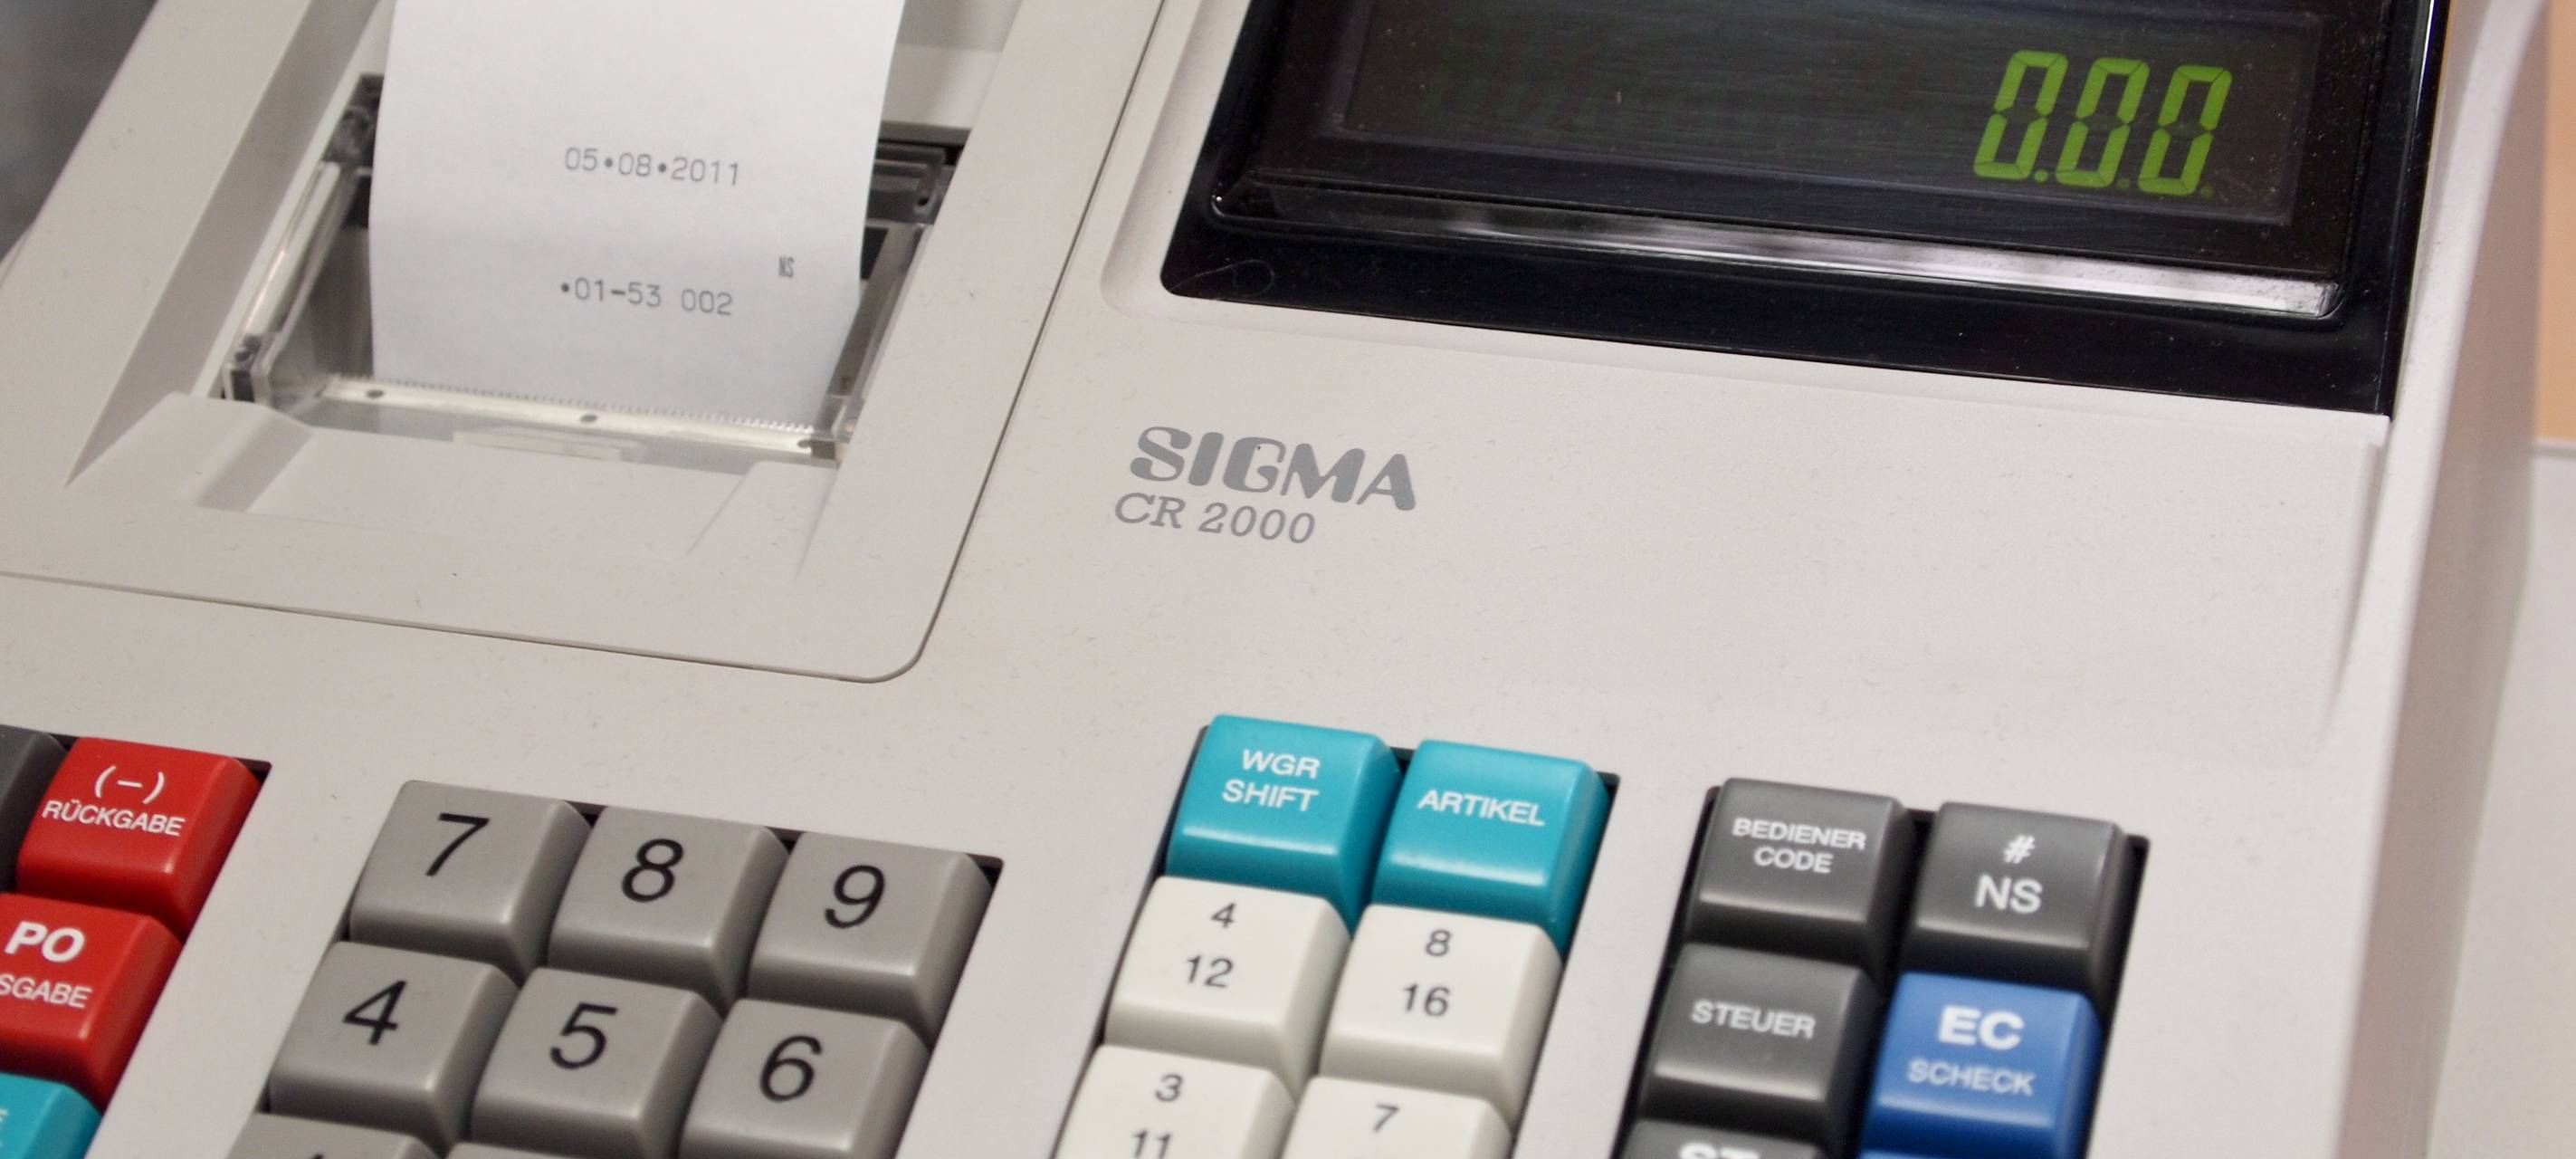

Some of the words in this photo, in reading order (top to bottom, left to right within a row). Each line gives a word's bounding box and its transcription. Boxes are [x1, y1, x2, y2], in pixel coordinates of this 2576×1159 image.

[1973, 50, 2232, 196] 0.00
[778, 256, 794, 278] NS
[681, 288, 734, 316] 002
[1130, 426, 1417, 512] SIGMA
[1114, 492, 1187, 530] CR
[1197, 502, 1316, 544] 2000
[1241, 748, 1321, 780] WGR
[1221, 779, 1320, 813] SHIFT
[1417, 789, 1547, 828] ARTIKEL
[42, 799, 186, 837] RÜCKGABE
[1732, 817, 1867, 851] BEDIENER
[434, 812, 490, 878] 7
[1753, 845, 1833, 875] CODE
[620, 838, 685, 903] 8
[824, 865, 886, 930] 9
[1975, 874, 2044, 915] NS
[1211, 901, 1237, 930] 4
[5, 920, 86, 963] PO
[1425, 928, 1451, 957] 8
[1185, 954, 1234, 989] 12
[342, 980, 408, 1046] 4
[1402, 982, 1450, 1017] 16
[549, 1001, 618, 1071] 5
[1692, 1000, 1817, 1039] STEUER
[1938, 1004, 2025, 1050] EC
[758, 1035, 824, 1103] 6
[1155, 1074, 1184, 1103] 3
[1907, 1058, 2037, 1097] SCHECK
[1372, 1103, 1400, 1134] 7
[1133, 1130, 1174, 1159] 11
